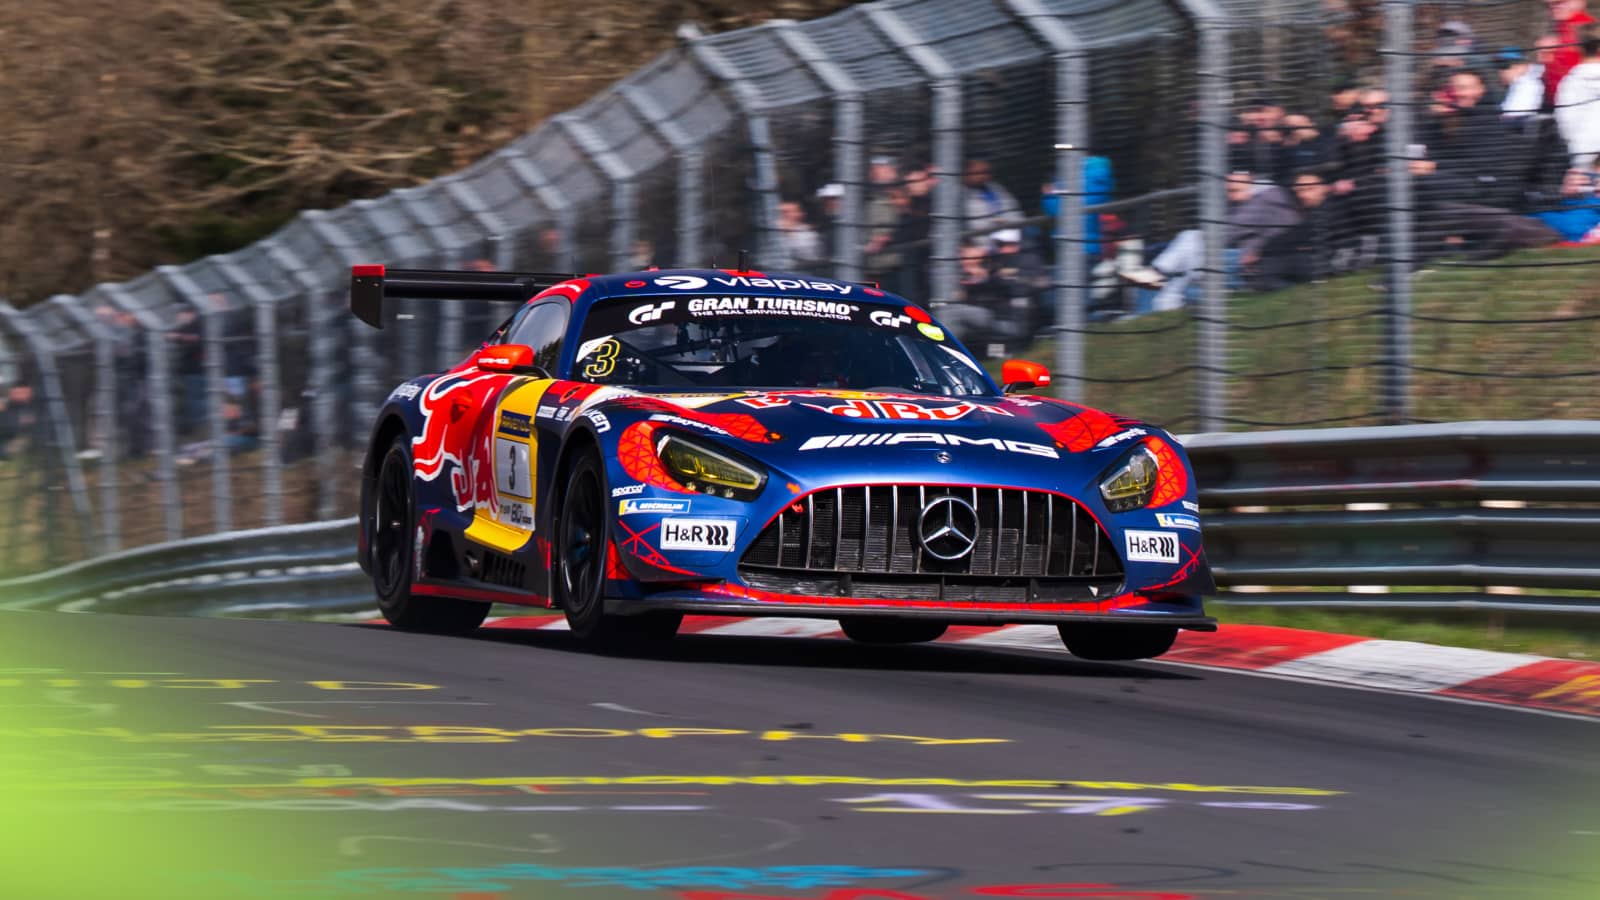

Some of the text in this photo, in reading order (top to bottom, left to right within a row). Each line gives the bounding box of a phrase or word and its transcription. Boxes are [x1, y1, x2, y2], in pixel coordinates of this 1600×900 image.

[713, 276, 853, 295] viaplay
[688, 297, 749, 313] GRAN
[745, 309, 789, 317] DRIVING
[792, 310, 852, 321] SIMULATOR
[585, 339, 620, 378] 3
[888, 433, 1060, 459] AMG
[508, 445, 517, 490] 3
[664, 524, 704, 543] H&R
[1128, 536, 1159, 556] H&R
